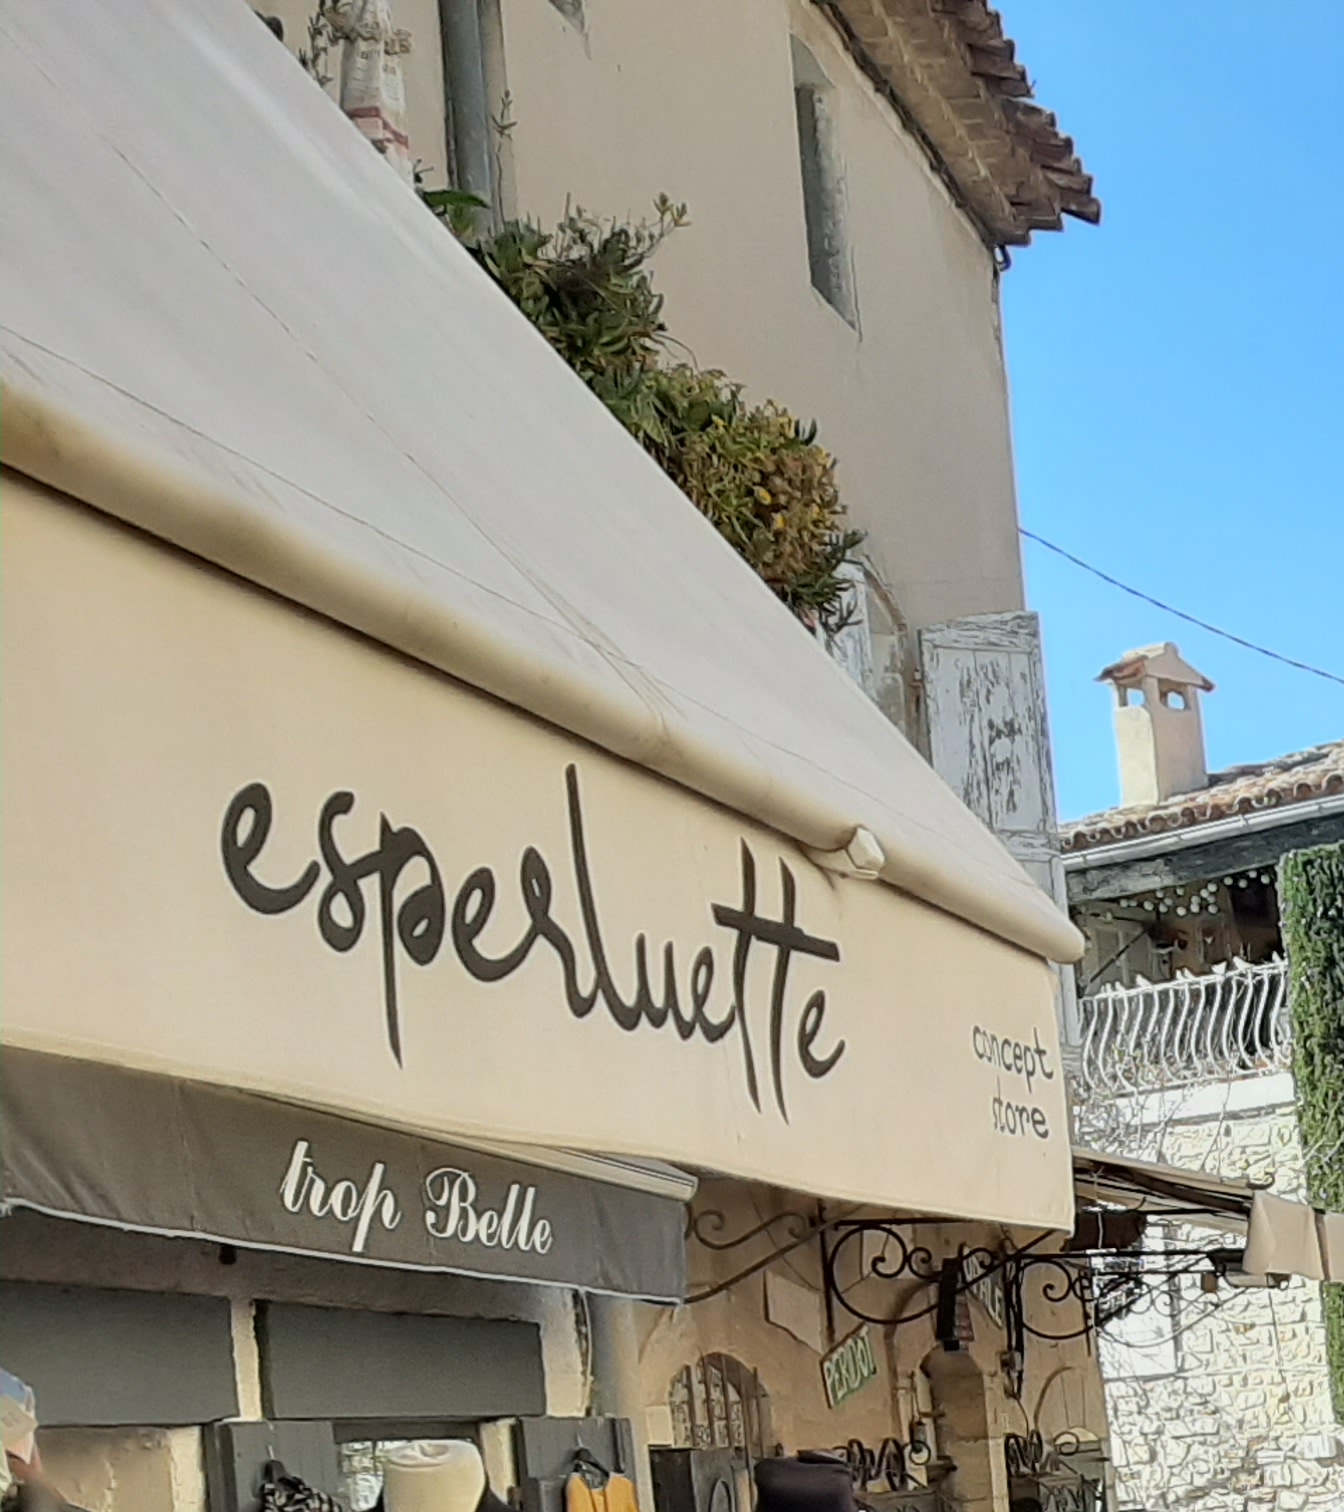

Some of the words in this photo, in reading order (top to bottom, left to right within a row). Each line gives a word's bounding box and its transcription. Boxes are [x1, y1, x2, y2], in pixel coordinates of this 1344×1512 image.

[221, 763, 846, 1126] esperluette
[972, 1024, 1054, 1094] concept
[992, 1075, 1049, 1139] store
[279, 1140, 402, 1252] trop
[425, 1167, 553, 1254] Belle
